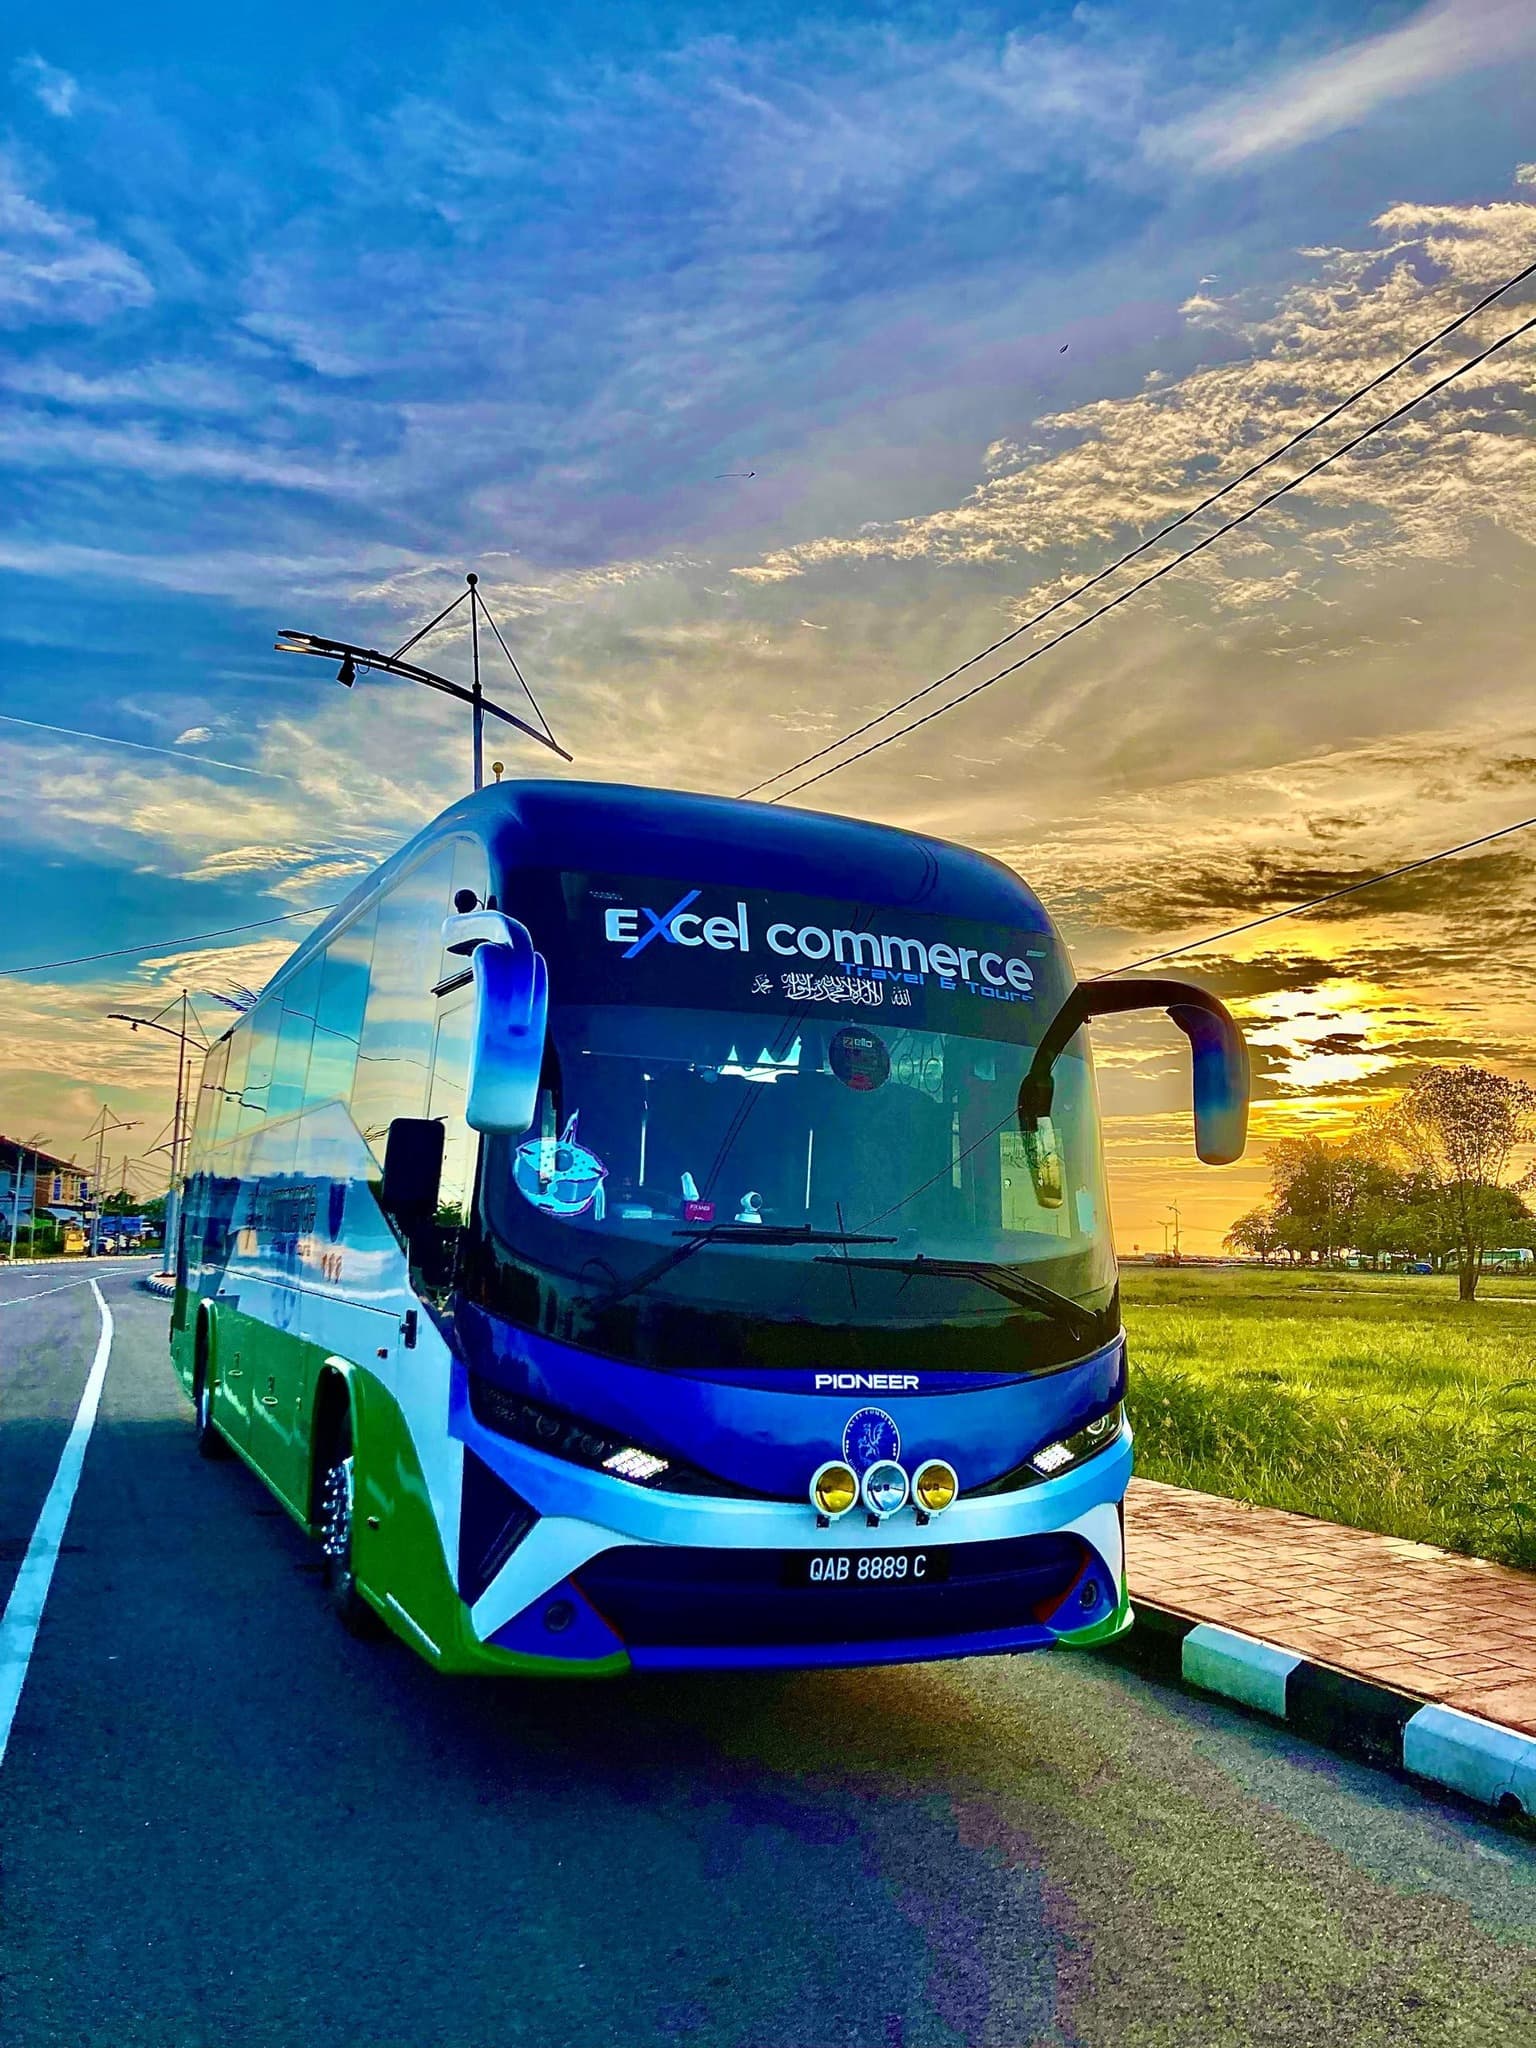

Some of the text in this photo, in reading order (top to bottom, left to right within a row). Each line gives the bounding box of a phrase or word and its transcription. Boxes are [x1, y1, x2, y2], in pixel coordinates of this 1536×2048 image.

[766, 922, 1035, 992] commerce
[839, 962, 925, 985] Travel
[940, 977, 957, 990] &
[815, 1374, 919, 1390] PIONEER
[809, 1554, 927, 1581] QAB 8889 C
